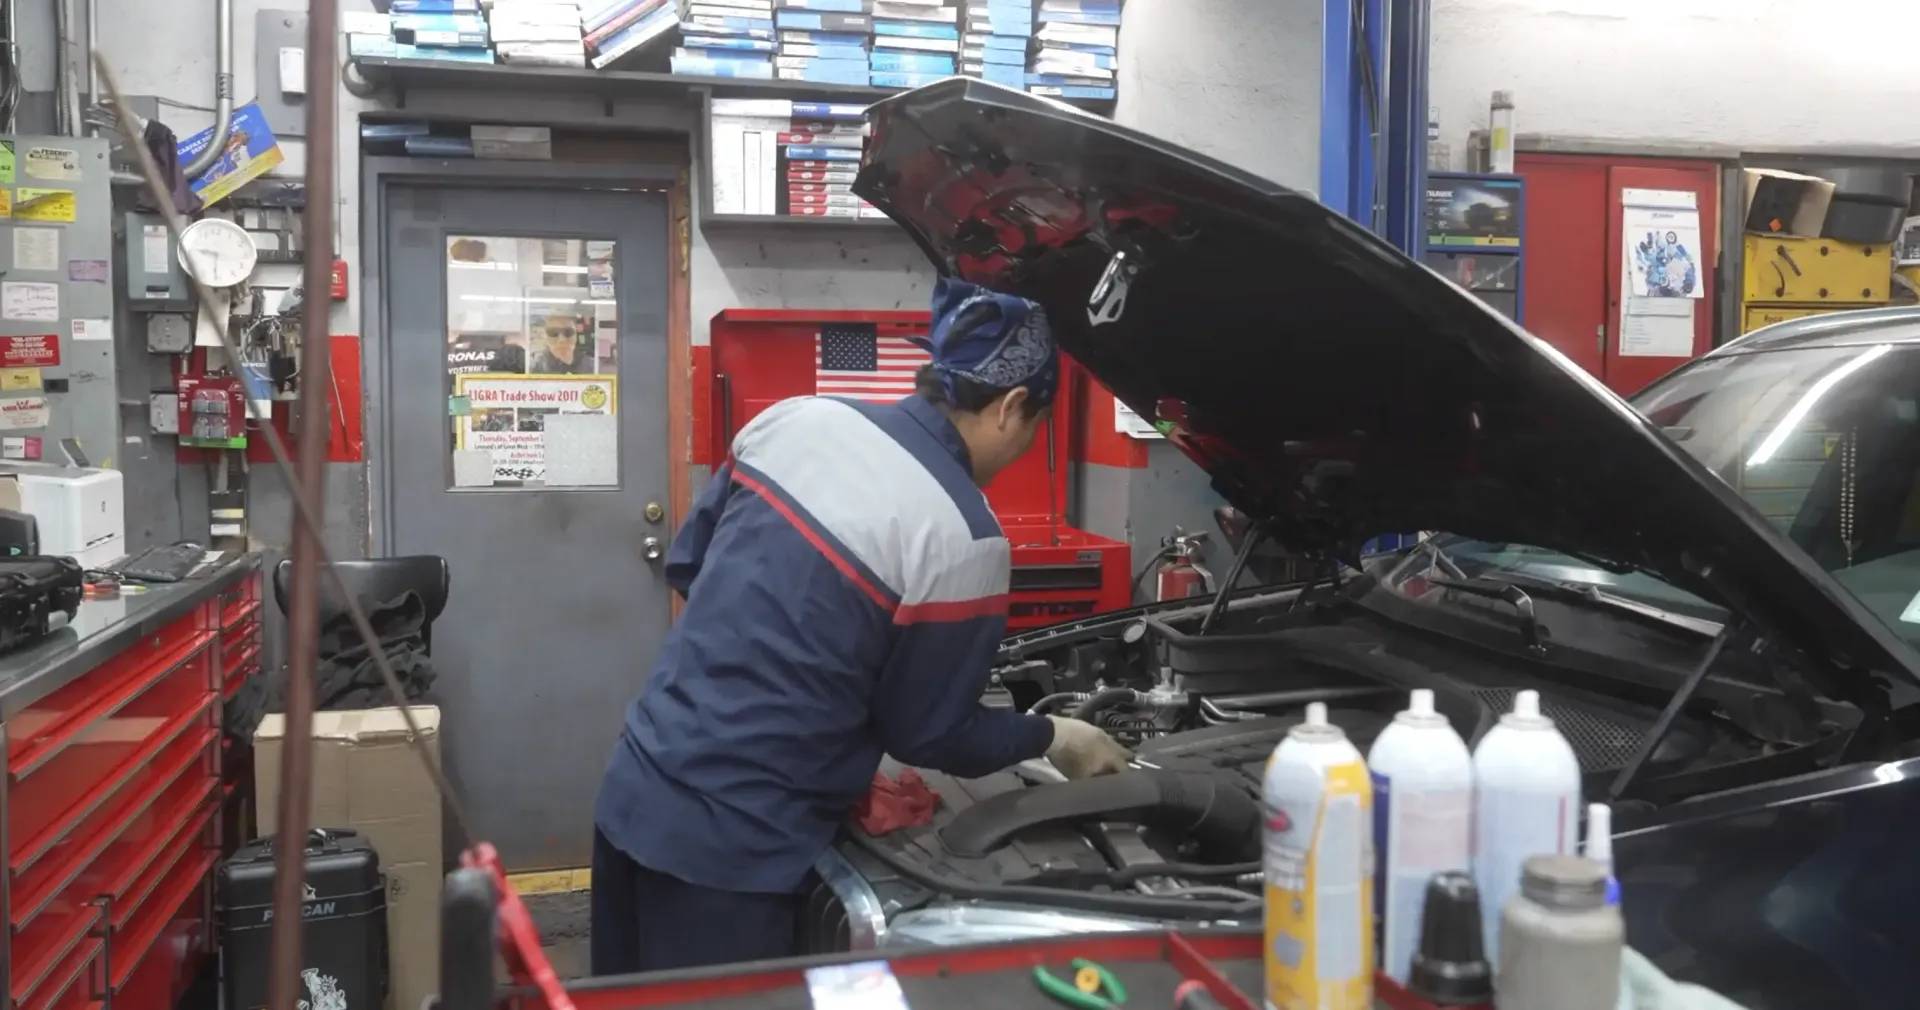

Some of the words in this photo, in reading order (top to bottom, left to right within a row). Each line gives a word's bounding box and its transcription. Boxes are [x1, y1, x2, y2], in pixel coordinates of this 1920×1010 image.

[500, 390, 526, 402] Trade
[529, 390, 556, 402] Show
[558, 390, 579, 402] 2017
[262, 901, 336, 922] PCAN
